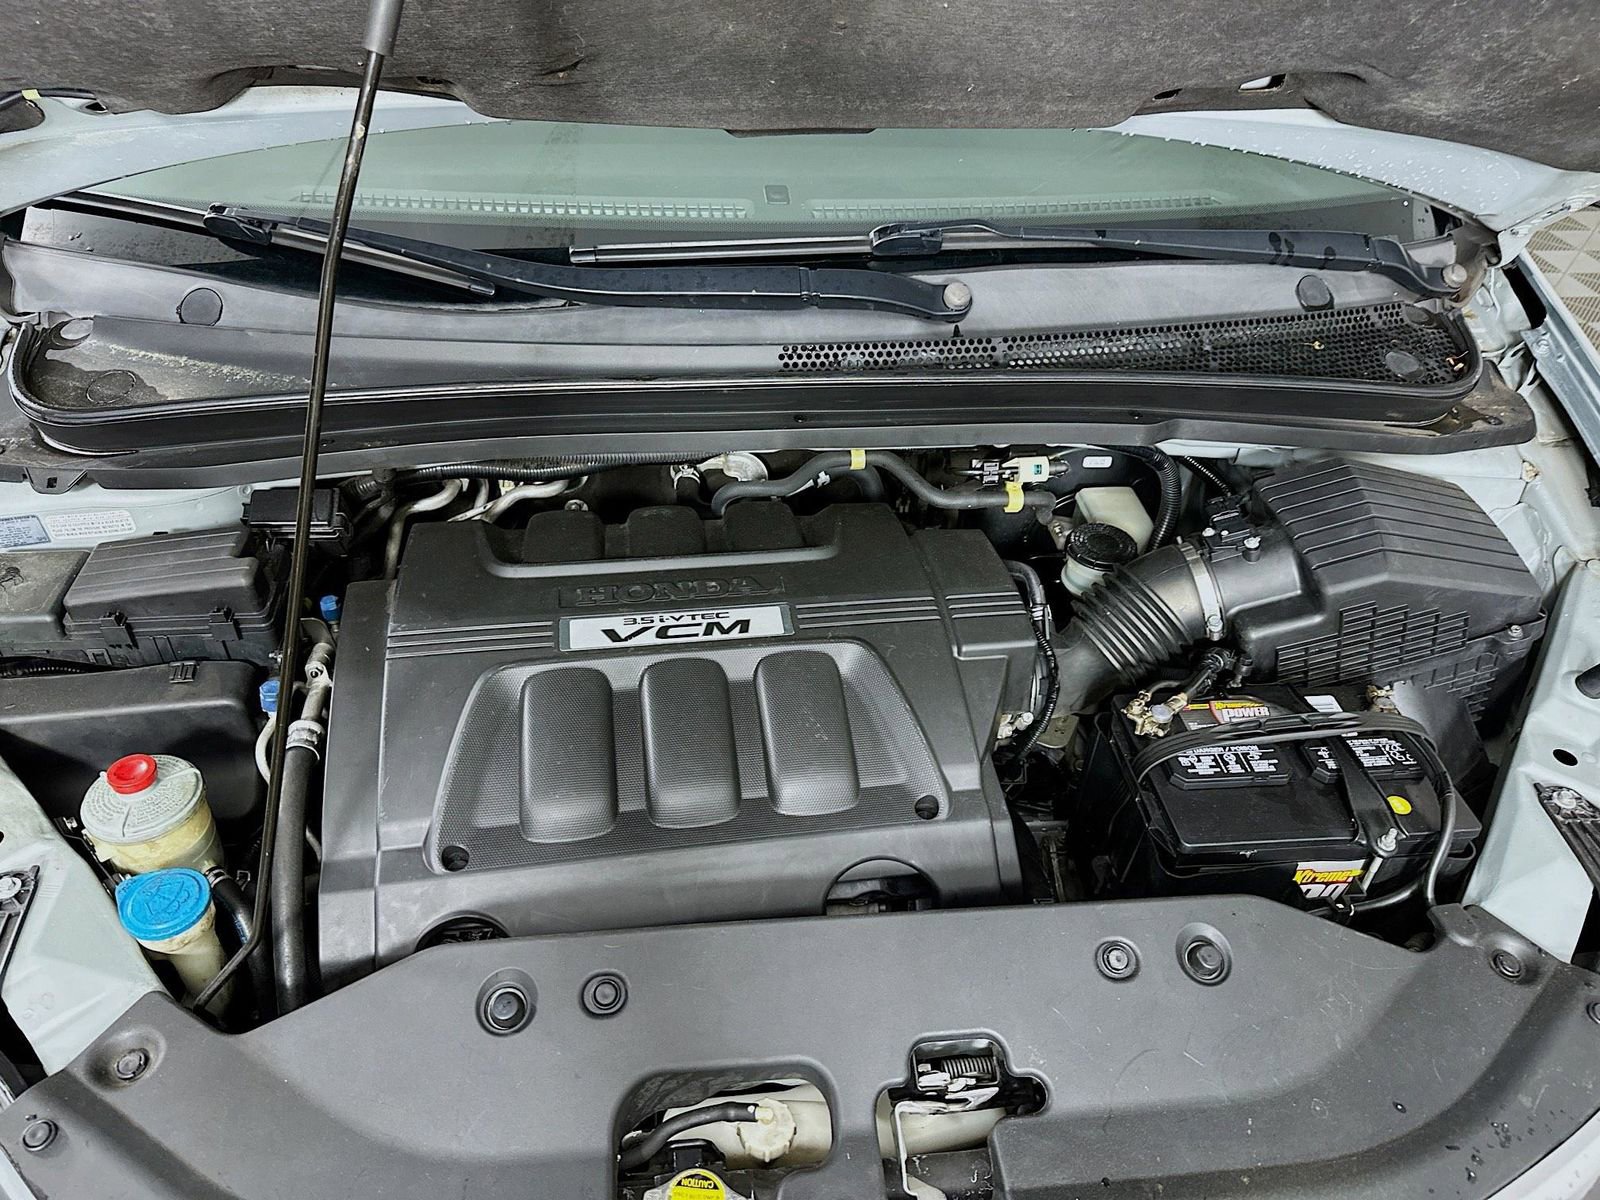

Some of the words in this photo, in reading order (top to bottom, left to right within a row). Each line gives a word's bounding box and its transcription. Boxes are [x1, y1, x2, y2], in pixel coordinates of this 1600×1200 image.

[576, 577, 767, 606] HONDA
[623, 615, 654, 626] 3.5
[658, 611, 730, 624] i-VTEC
[600, 618, 752, 643] VCM
[681, 1178, 714, 1188] CAUTION
